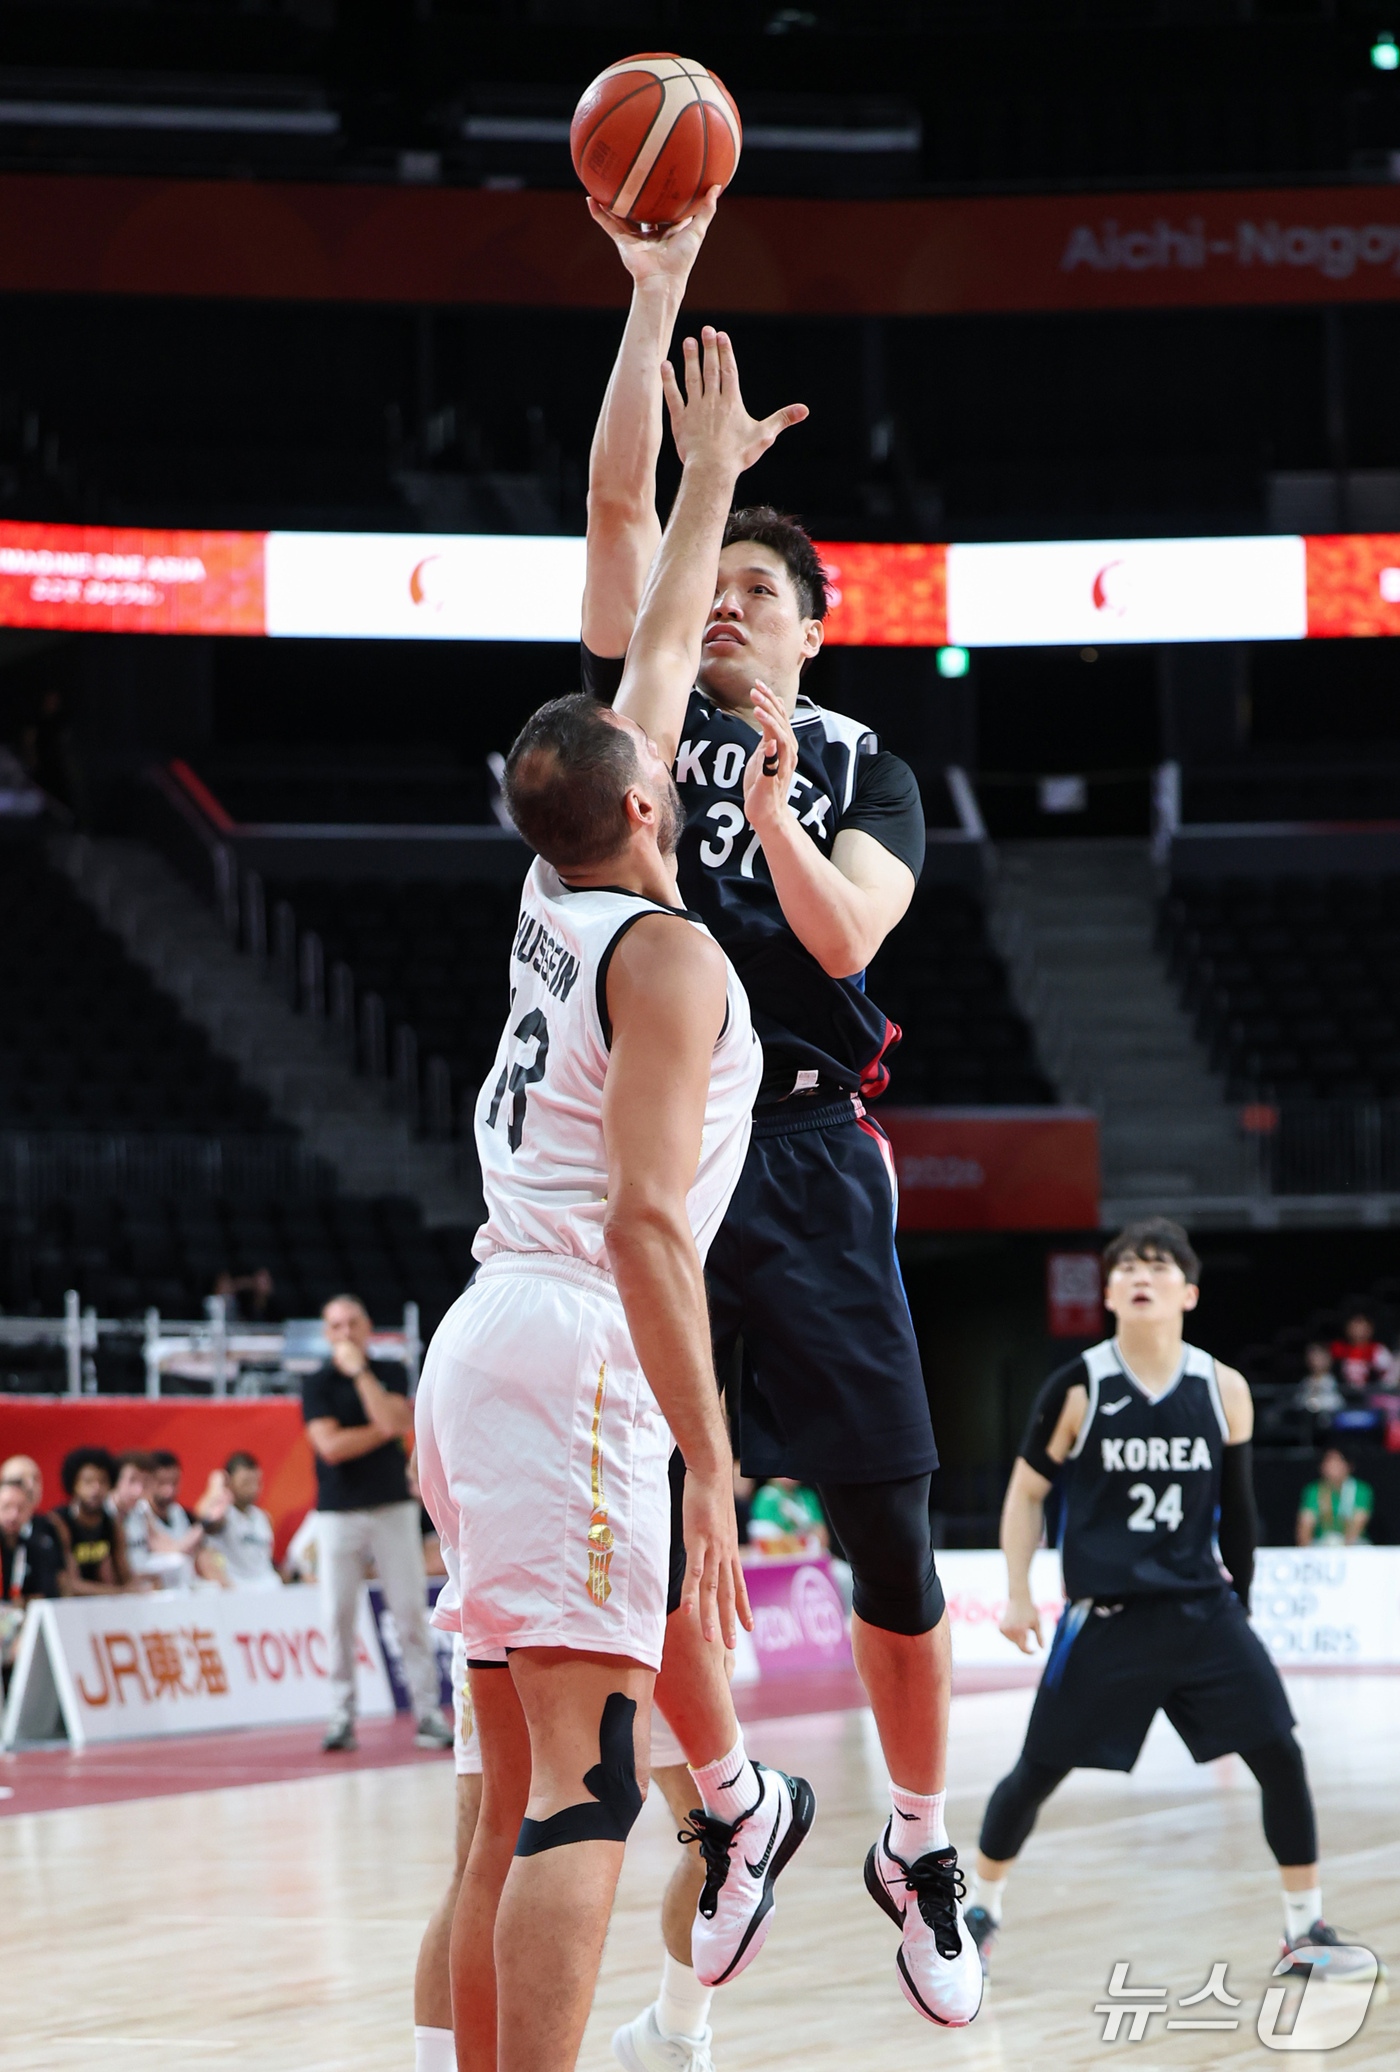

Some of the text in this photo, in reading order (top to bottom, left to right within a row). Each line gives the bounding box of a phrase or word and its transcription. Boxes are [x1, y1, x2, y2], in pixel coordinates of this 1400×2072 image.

[675, 739, 832, 840] KOEA
[1102, 1437, 1212, 1472] KOREA
[1127, 1483, 1184, 1532] 24
[77, 1624, 229, 1706] JR東海
[234, 1627, 376, 1684] TOYOA
